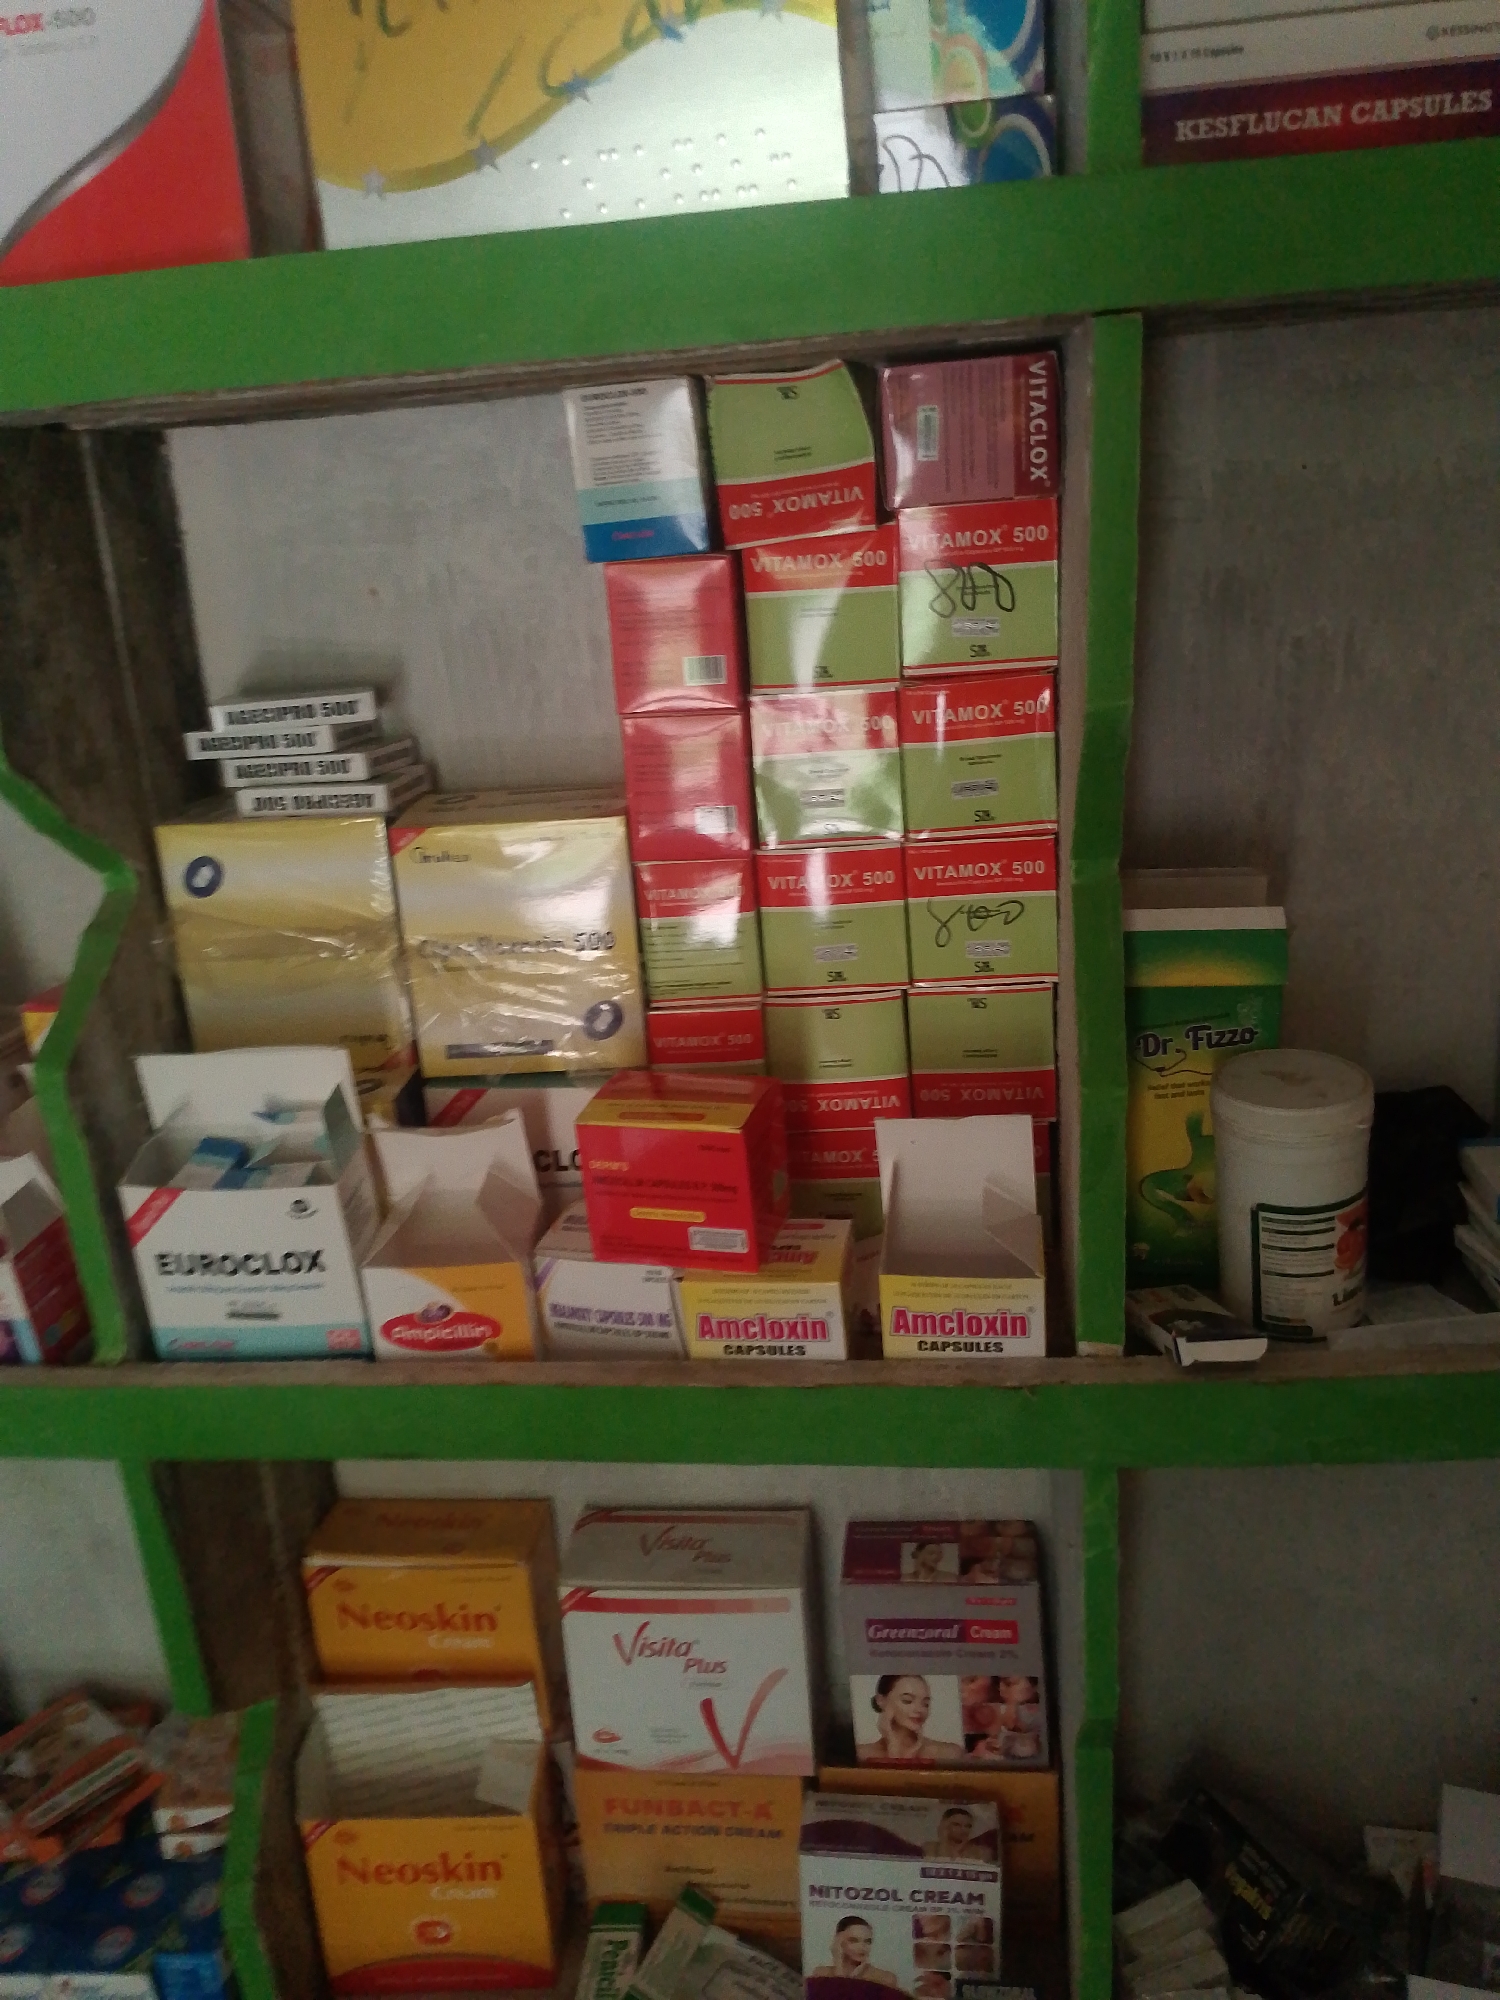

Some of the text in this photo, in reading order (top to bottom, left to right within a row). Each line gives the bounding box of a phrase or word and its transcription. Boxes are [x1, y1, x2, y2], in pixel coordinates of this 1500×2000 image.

[1175, 89, 1493, 142] KESFLUCAN CAPSULES
[1028, 360, 1048, 481] VITACLOX
[729, 486, 864, 520] VITAMOX 500
[1013, 525, 1049, 543] 500
[750, 552, 843, 573] VITAMOX
[911, 698, 1047, 725] VITAMOX 500
[767, 870, 896, 890] VITAOX 500
[914, 859, 1046, 880] VITAMOX 500
[1185, 1023, 1259, 1051] Fizzo
[817, 1093, 901, 1112] VITAMOX
[155, 1250, 327, 1277] EUROCLOX
[697, 1313, 830, 1342] Amcloxin
[890, 1306, 1030, 1338] Amcloxin
[723, 1344, 806, 1357] CAPSULES
[917, 1340, 1004, 1353] CAPSULES
[337, 1602, 498, 1632] Neoskin
[683, 1658, 728, 1674] Plus
[661, 1824, 720, 1837] ACTION
[724, 1826, 782, 1839] CREAM
[337, 1851, 502, 1885] Neoskin
[809, 1884, 986, 1907] NITOZOL CREAM
